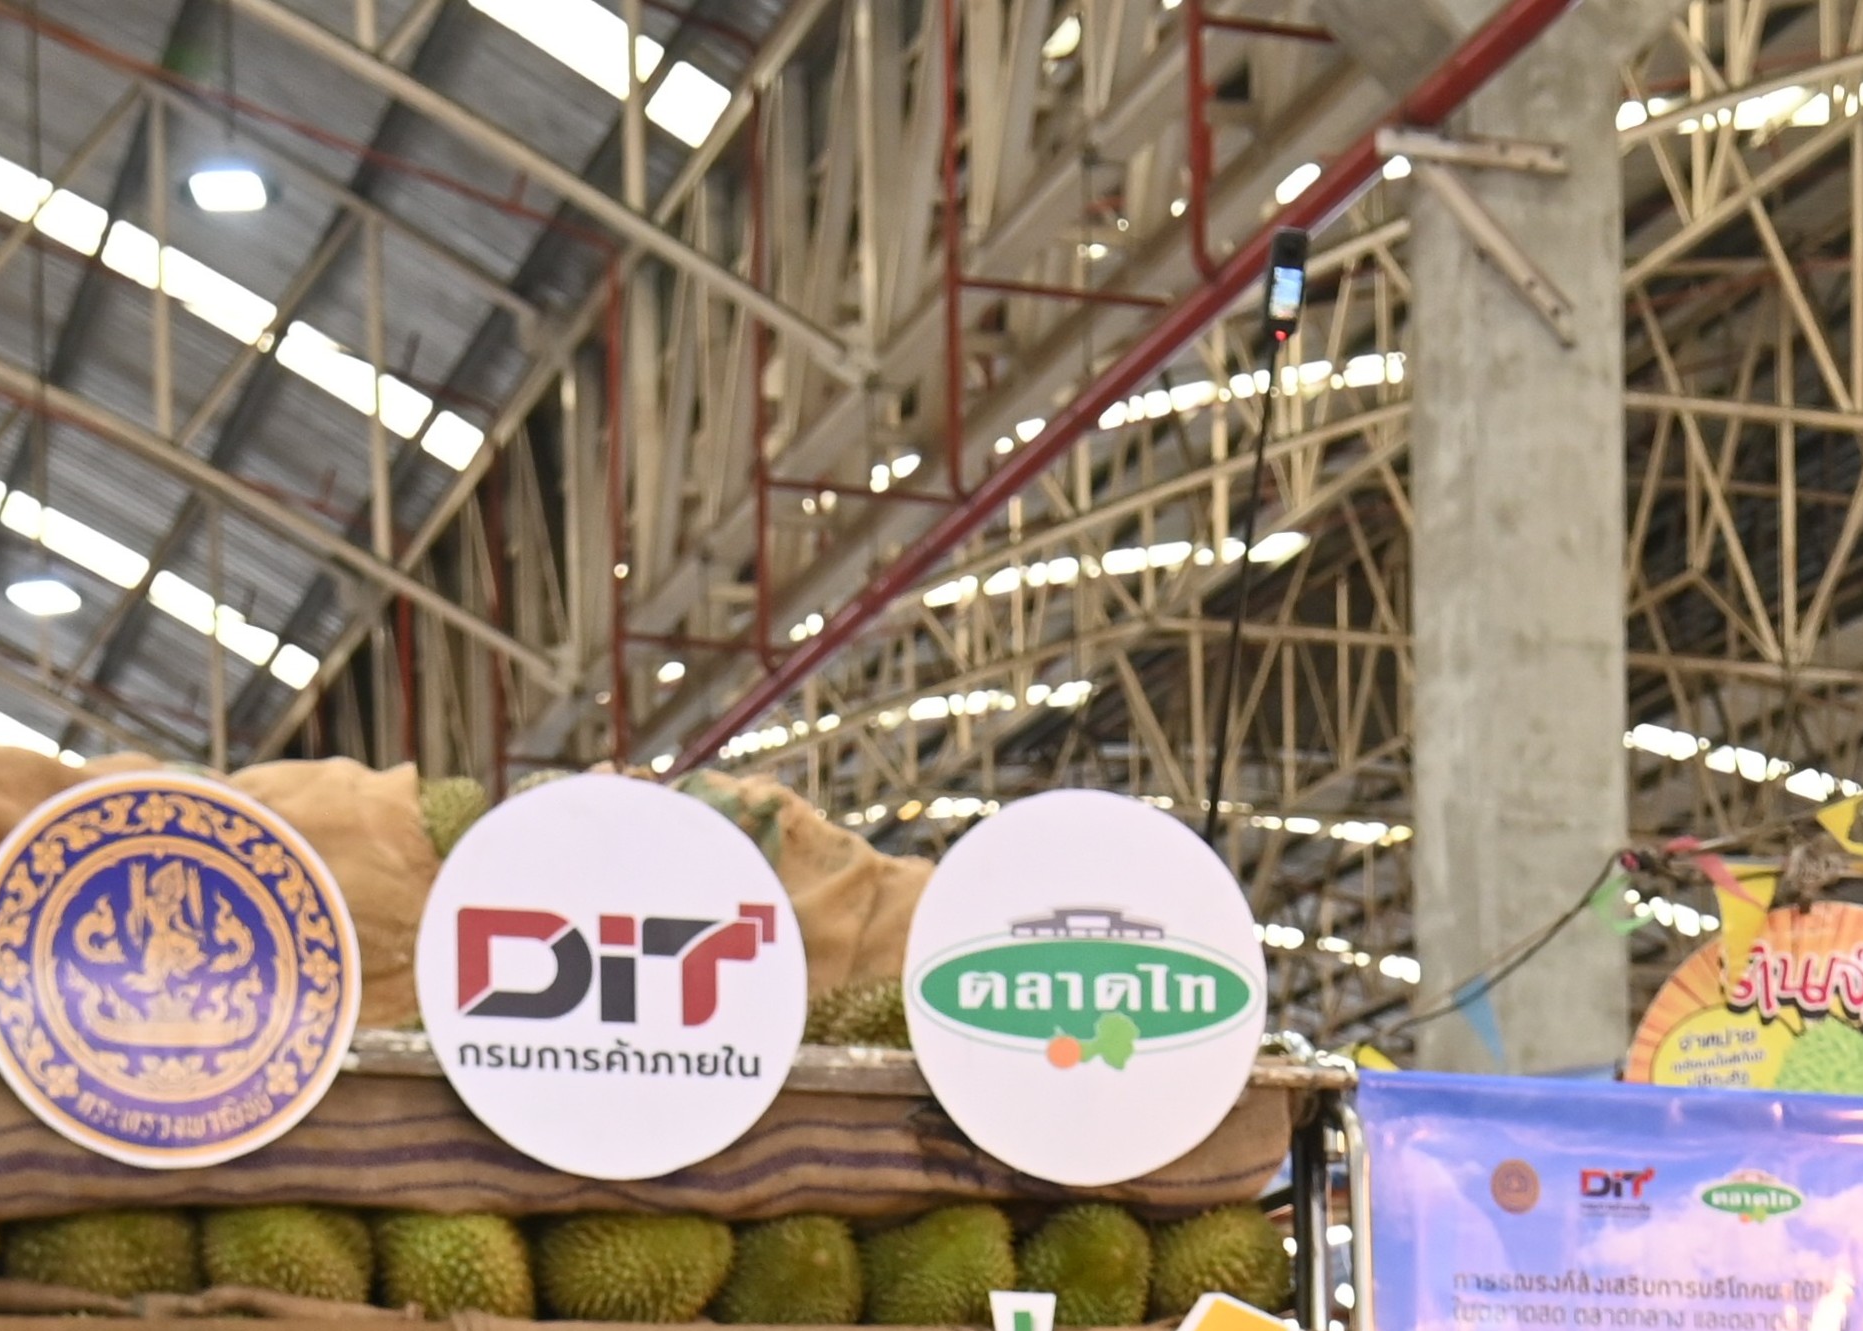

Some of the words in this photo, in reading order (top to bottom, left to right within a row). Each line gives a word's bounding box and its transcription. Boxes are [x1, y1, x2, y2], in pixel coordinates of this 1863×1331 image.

[958, 963, 1216, 1012] ตลาดไท
[458, 1039, 761, 1078] กรมการค้าภายใน
[77, 1079, 274, 1139] กระทรวงพาณิชย์
